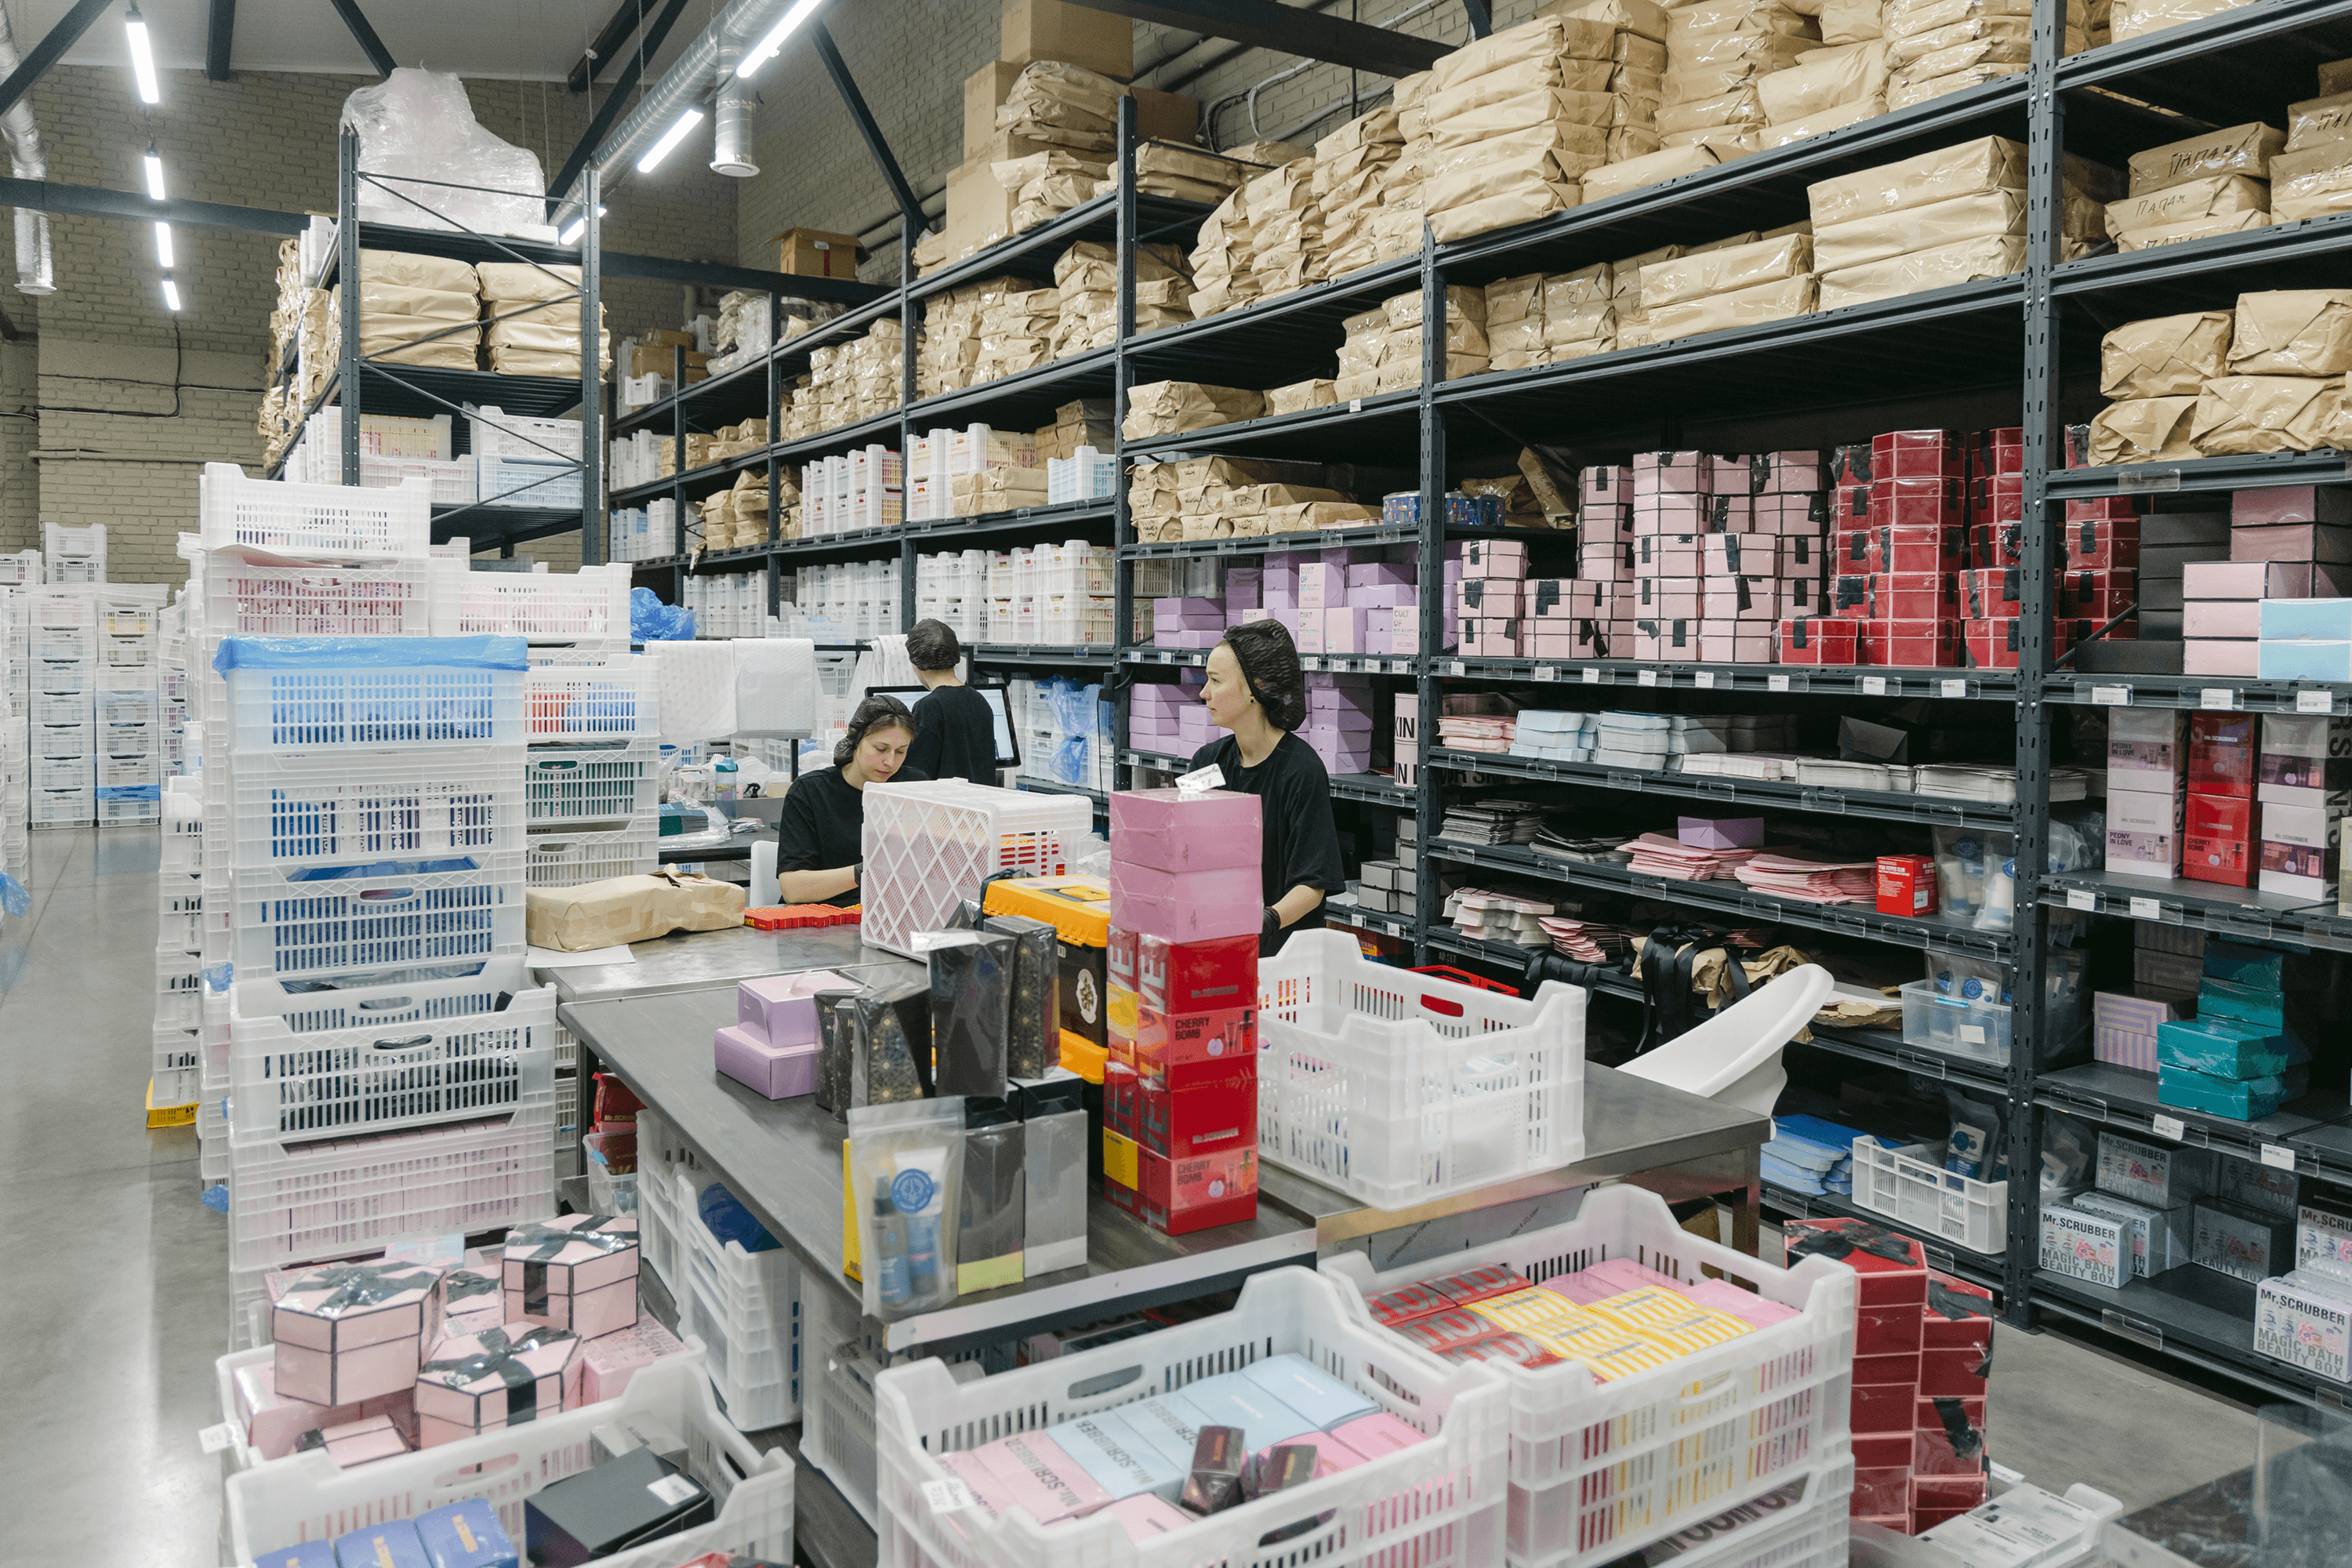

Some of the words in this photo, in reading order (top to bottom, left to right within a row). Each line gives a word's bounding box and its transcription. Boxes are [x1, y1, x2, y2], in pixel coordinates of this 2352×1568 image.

[2187, 837, 2211, 846] CHERRY
[1174, 1016, 1210, 1030] CHERRY
[1174, 1028, 1201, 1040] BOMB
[2100, 1134, 2167, 1163] Mr.SCRUBBER
[1177, 1160, 1211, 1174] CHERRY
[1177, 1172, 1203, 1185] BOMB
[2042, 1213, 2116, 1241] Mr.SCRUBBER
[2042, 1247, 2080, 1267] MAGIC
[2085, 1258, 2115, 1276] BATH
[2042, 1258, 2085, 1278] BEAUTY
[2091, 1269, 2115, 1286] BOX
[2195, 1255, 2238, 1275] BEAUTY
[2260, 1289, 2346, 1327] Mr.SCRUBBER
[2257, 1339, 2308, 1367] BEAUTY
[2314, 1358, 2343, 1378] BOX
[2258, 1327, 2302, 1352] MAGIC
[2307, 1346, 2344, 1367] BATH
[1075, 1420, 1154, 1485] Mr.SCRUBBER
[1004, 1437, 1083, 1508] Mr.SCRUBBER
